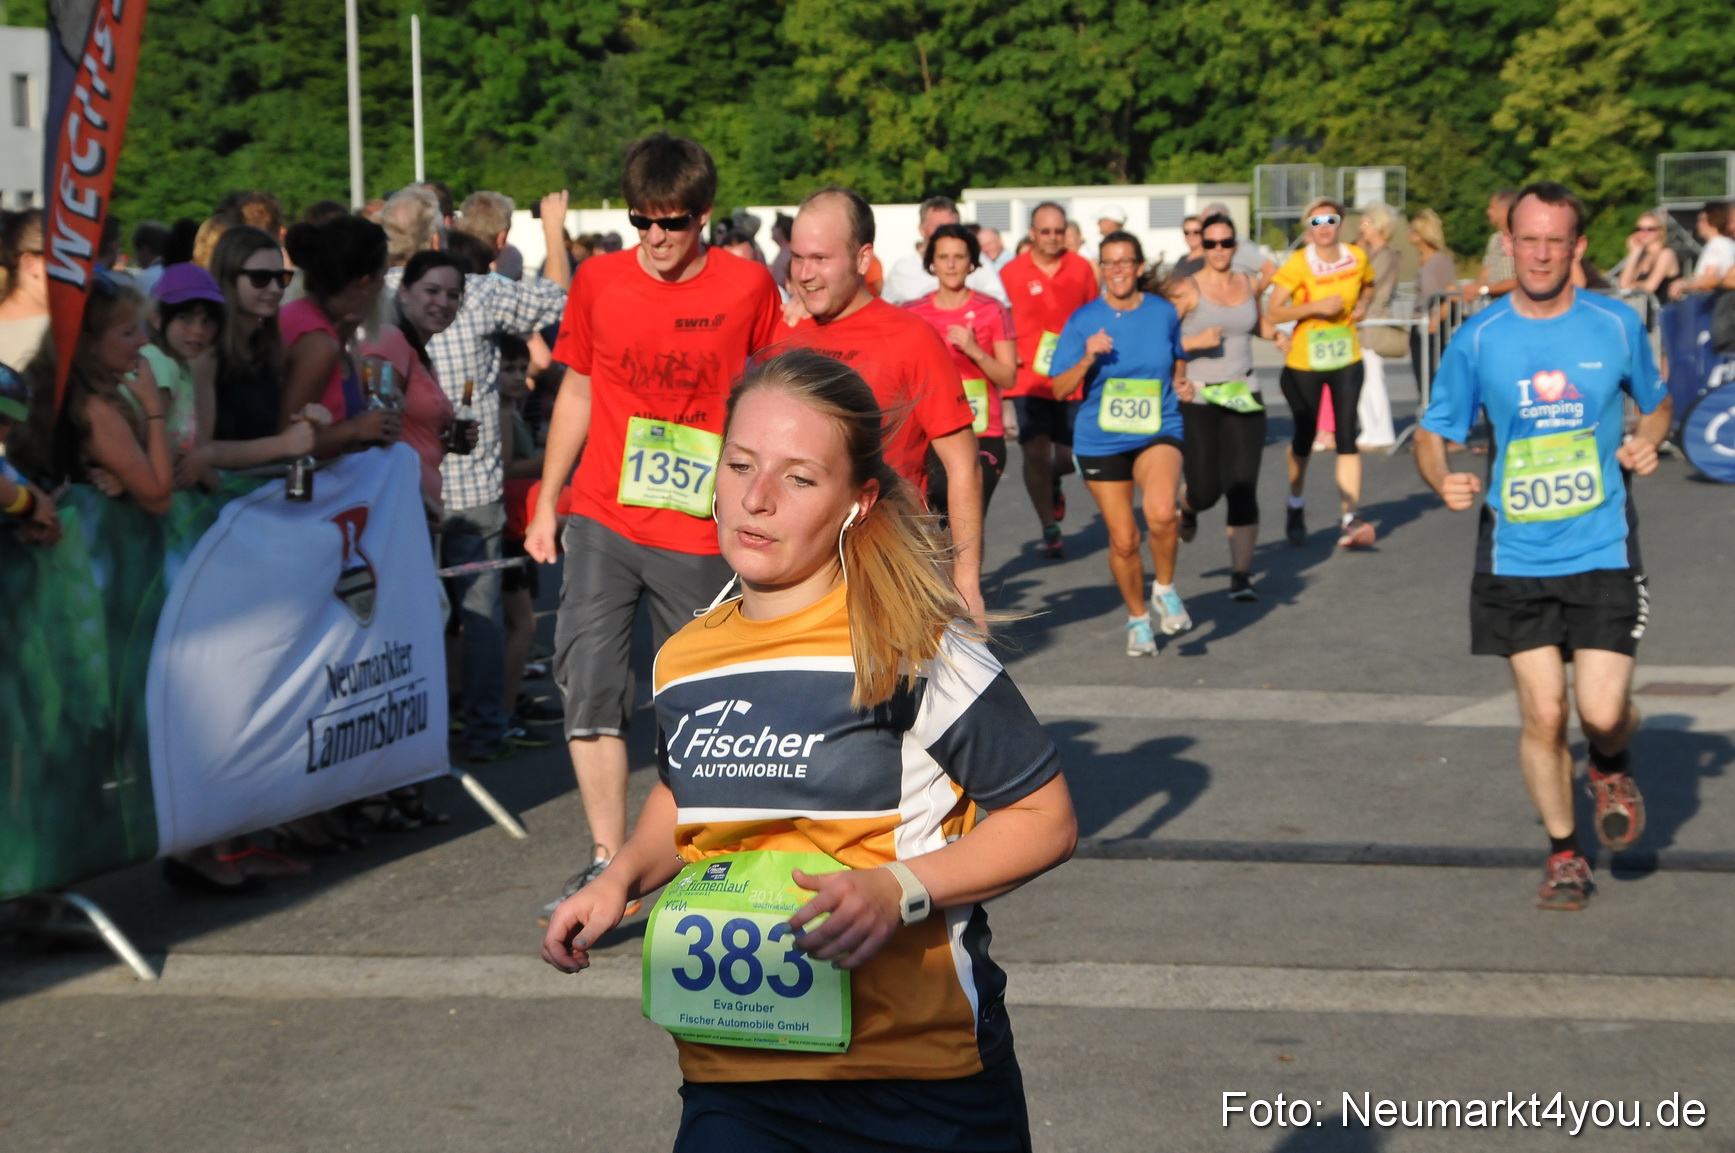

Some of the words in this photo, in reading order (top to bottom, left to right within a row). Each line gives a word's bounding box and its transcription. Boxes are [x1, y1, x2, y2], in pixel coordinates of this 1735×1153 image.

[46, 0, 122, 290] WECHS
[1315, 340, 1347, 360] 812
[1517, 379, 1533, 407] I
[1110, 398, 1151, 419] 630
[1519, 400, 1584, 419] camping
[628, 450, 712, 494] 1357
[1509, 471, 1596, 511] 5059
[325, 641, 412, 700] Neumarkter
[306, 682, 428, 775] Lammsbräu
[683, 725, 825, 759] Fischer
[692, 763, 808, 779] AUTOMOBILE
[686, 879, 750, 894] firmenlauf
[748, 889, 784, 904] 2014
[672, 914, 814, 998] 383
[713, 999, 733, 1011] Eva
[735, 1001, 775, 1013] Gruber
[679, 1013, 715, 1026] Fischer
[717, 1016, 774, 1030] Automobile
[777, 1021, 810, 1032] GmbH
